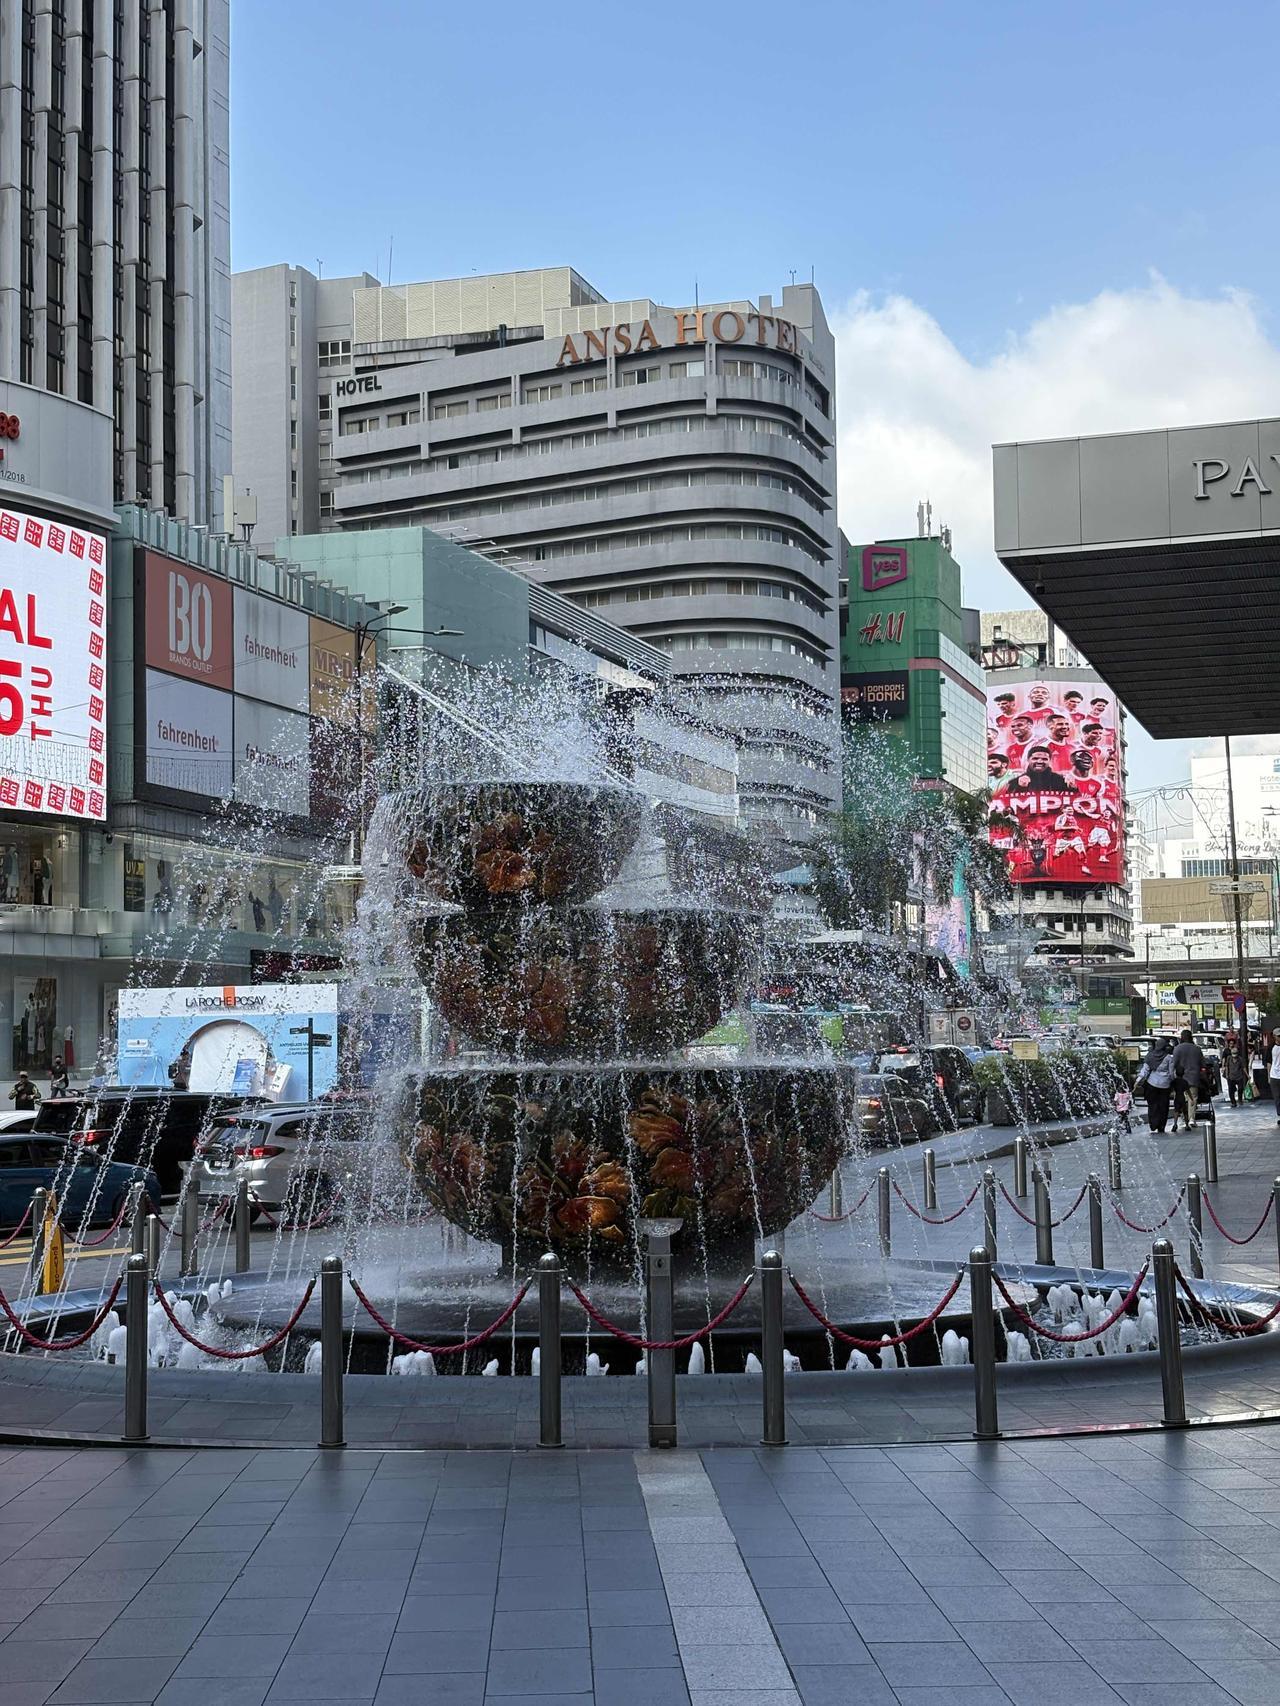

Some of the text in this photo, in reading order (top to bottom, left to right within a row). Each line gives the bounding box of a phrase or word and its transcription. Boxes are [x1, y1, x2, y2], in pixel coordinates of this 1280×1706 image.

[556, 310, 804, 366] ANSA HOTEL
[336, 375, 382, 397] HOTEL
[1192, 454, 1280, 500] PA
[873, 559, 899, 576] yes
[0, 588, 52, 649] AL
[168, 571, 213, 662] BO
[859, 611, 906, 645] H&M
[169, 651, 213, 674] BRANDS OUTLET
[244, 634, 297, 668] fahrenheit
[31, 666, 52, 741] THU
[157, 719, 217, 752] fahrenheit
[185, 997, 198, 1008] LA
[198, 996, 233, 1007] ROCHE
[234, 994, 266, 1006] POSAY
